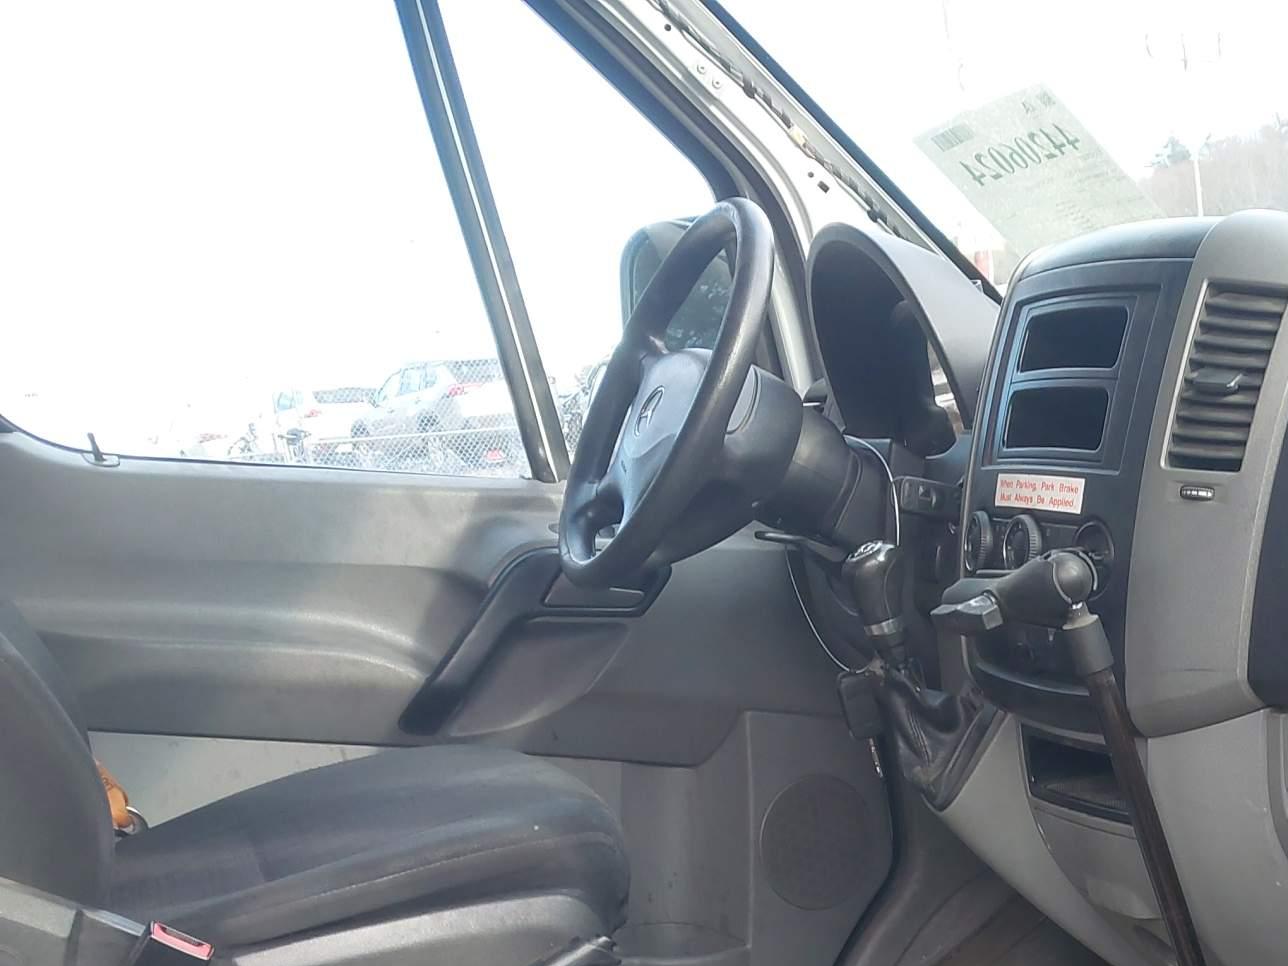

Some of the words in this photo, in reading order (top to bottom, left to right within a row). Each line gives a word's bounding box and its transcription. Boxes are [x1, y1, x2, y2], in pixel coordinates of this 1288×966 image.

[1001, 480, 1013, 488] When
[1041, 481, 1055, 491] Park
[1059, 483, 1079, 494] Brake
[1001, 493, 1011, 501] Must
[1014, 493, 1033, 504] Always
[1037, 495, 1045, 504] Be
